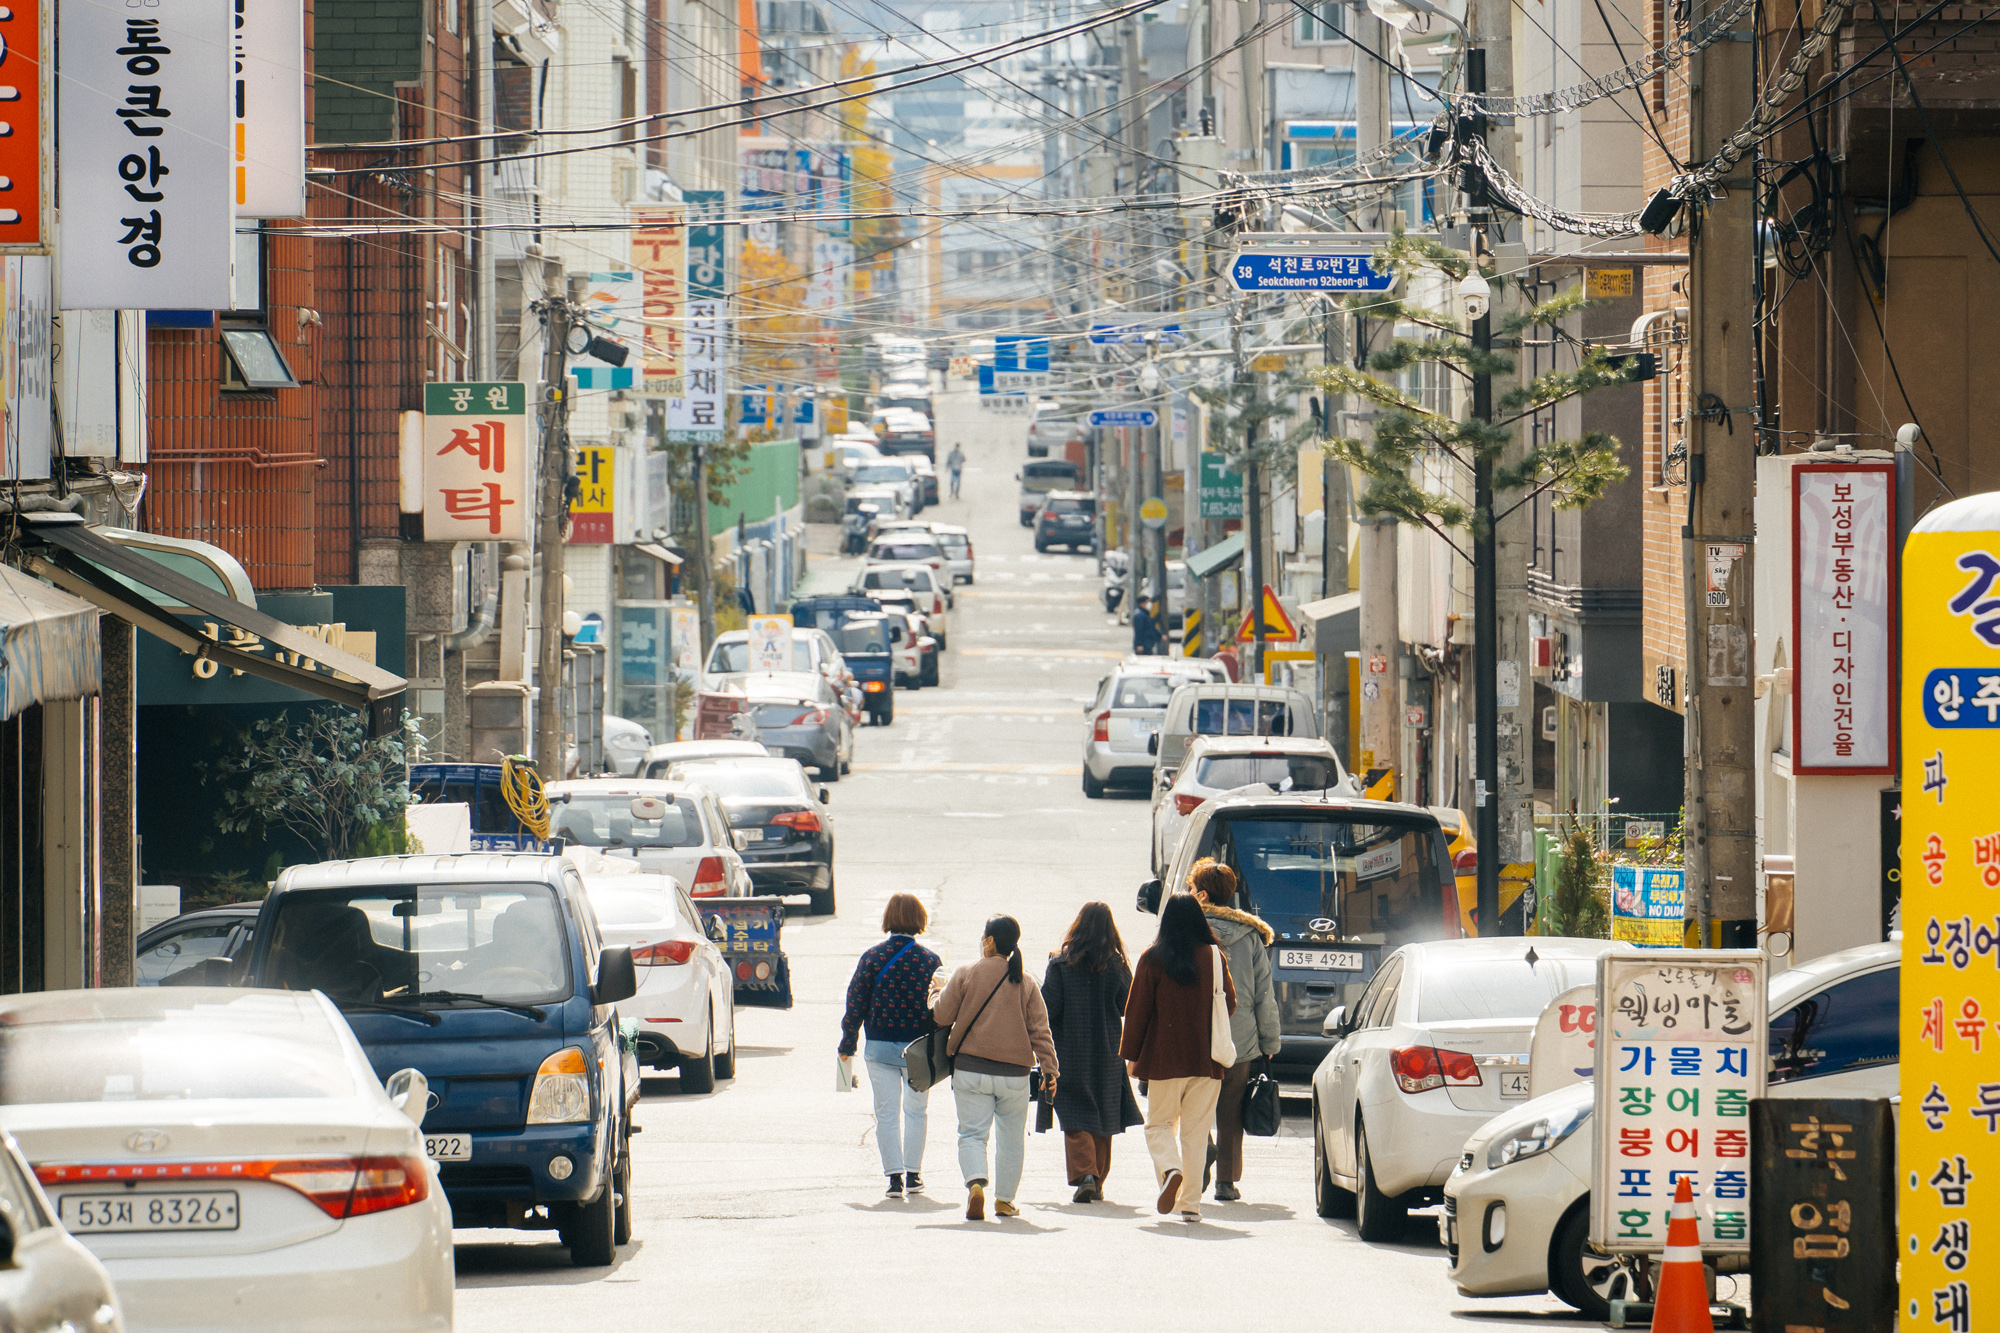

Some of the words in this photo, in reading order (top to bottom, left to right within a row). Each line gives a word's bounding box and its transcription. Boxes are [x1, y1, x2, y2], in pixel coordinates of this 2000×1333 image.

[116, 18, 171, 268] 통큰안경
[1238, 266, 1252, 278] 38
[1268, 258, 1314, 274] 석천로
[1316, 258, 1360, 274] 92번길
[1258, 276, 1318, 287] Seokcheon-ro
[1320, 276, 1368, 288] 92beon-gil
[690, 304, 716, 425] 전기재료
[449, 386, 509, 411] 공원
[436, 420, 515, 535] 세탁
[1933, 674, 2000, 722] 안주
[1922, 750, 1947, 804] 파
[1651, 873, 1680, 889] 쓰레기
[1648, 905, 1662, 917] NO
[1281, 932, 1361, 942] STARIA
[1921, 916, 2000, 970] 오징어
[1287, 952, 1313, 965] 83루
[1320, 954, 1354, 967] 4921
[1617, 990, 1752, 1035] 웰빙마을
[1921, 997, 2000, 1052] 제육
[1620, 1046, 1748, 1077] 가물치
[1619, 1087, 1750, 1117] 장어즙
[1618, 1127, 1749, 1158] 붕어즙
[1929, 1156, 1973, 1206] 삼
[78, 1200, 134, 1227] 53저
[149, 1198, 222, 1224] 8326
[1617, 1208, 1748, 1240] 호즙
[1931, 1221, 1969, 1271] 생
